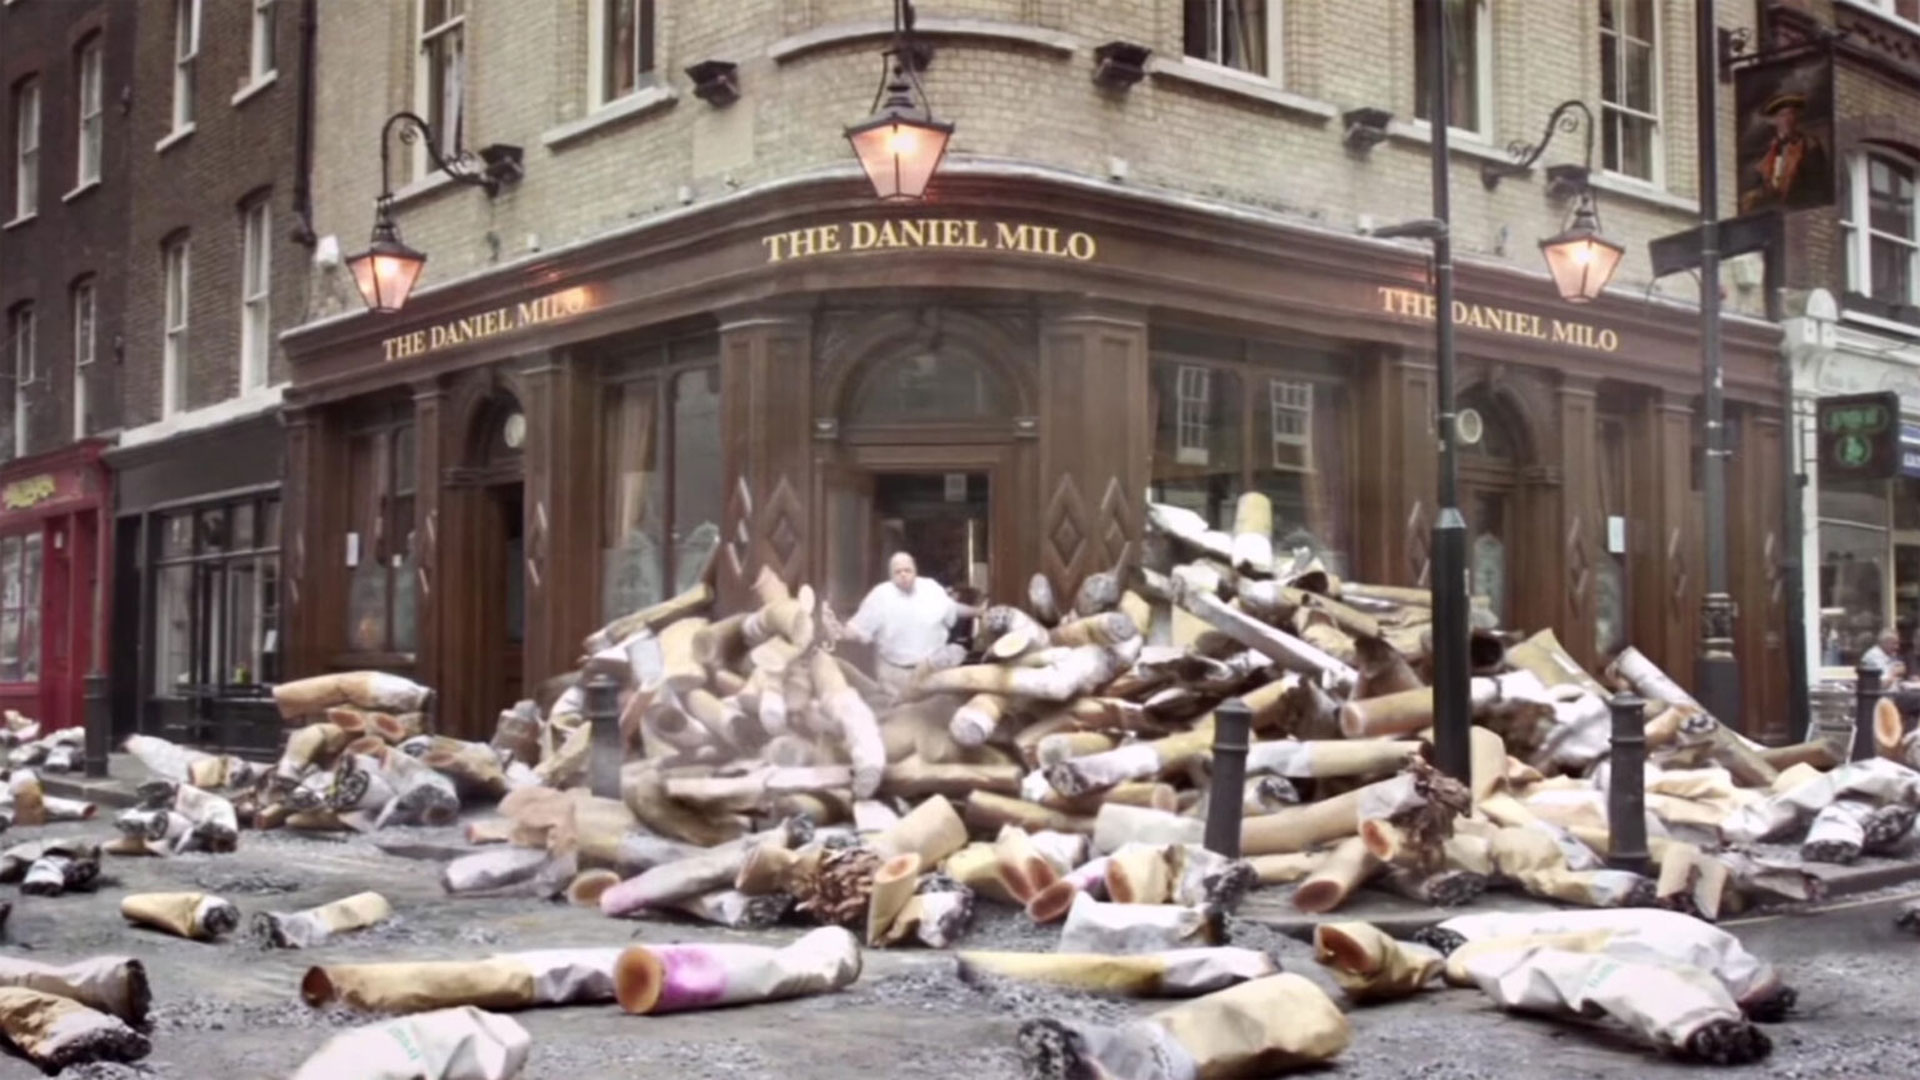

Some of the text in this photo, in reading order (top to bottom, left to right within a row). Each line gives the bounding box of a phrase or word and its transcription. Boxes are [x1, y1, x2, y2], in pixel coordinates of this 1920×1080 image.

[762, 219, 1096, 263] THE DANIEL MILO
[382, 331, 426, 361] THE
[431, 309, 512, 349] DANIEL
[1451, 301, 1546, 338] DANIEL
[1552, 320, 1617, 351] MILO
